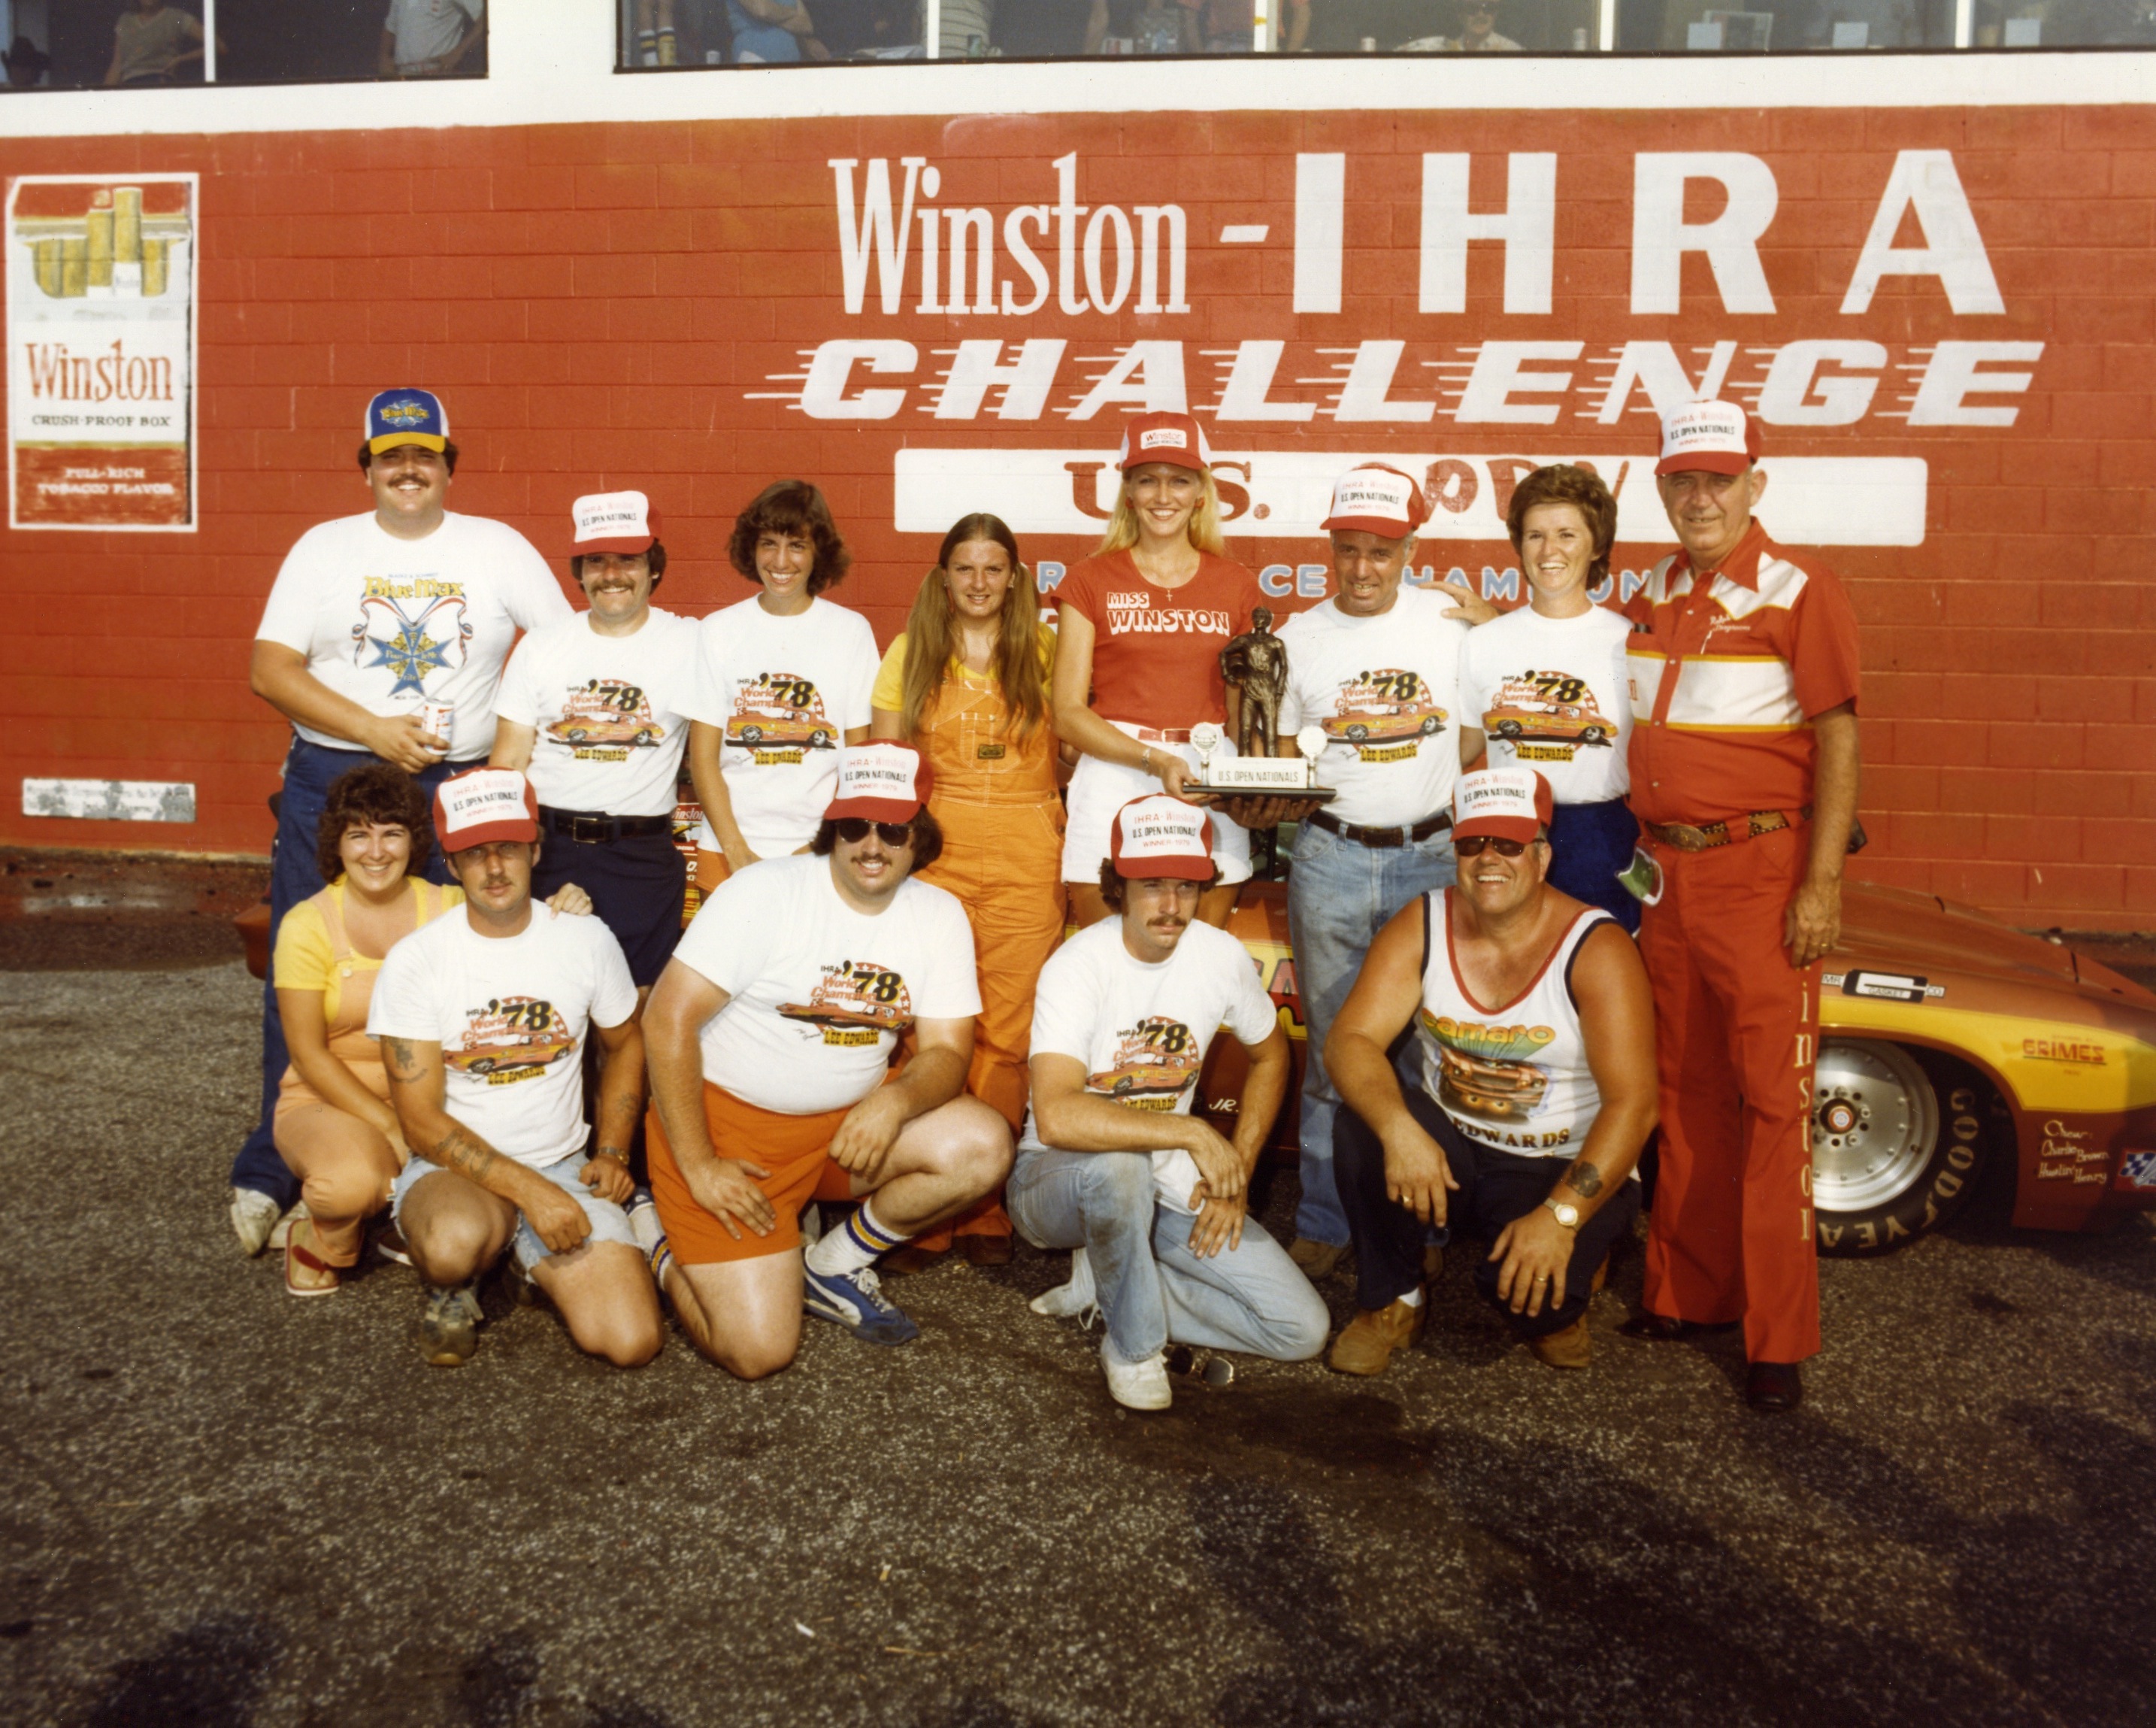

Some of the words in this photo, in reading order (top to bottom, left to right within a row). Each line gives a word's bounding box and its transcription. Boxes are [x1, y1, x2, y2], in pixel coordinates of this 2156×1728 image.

[828, 151, 1191, 316] Winston
[25, 338, 174, 403] Winston
[800, 339, 2045, 426] CHALLENGE
[140, 417, 171, 427] BOX
[364, 575, 414, 599] Blue
[414, 578, 464, 597] Max
[1107, 592, 1150, 610] MISS
[1107, 608, 1230, 637] WINSTON
[741, 687, 777, 698] World
[1361, 749, 1376, 762] LEE
[1379, 744, 1417, 761] EDWARDS
[1518, 745, 1531, 759] LEE
[1534, 746, 1573, 761] EDWARDS
[872, 771, 907, 783] NATIONALS
[1235, 771, 1254, 782] OPEN
[1256, 772, 1298, 782] NATIONALS
[466, 796, 483, 808] OPEN
[484, 792, 518, 802] NATIONALS
[1473, 790, 1488, 799] OPEN
[1491, 787, 1525, 799] NATIONALS
[1144, 826, 1161, 836] OPEN
[1164, 826, 1196, 837] NATIONALS
[823, 975, 858, 989] World
[810, 986, 877, 1002] Champion
[1867, 987, 1904, 998] GASKET
[825, 1030, 840, 1044] LEE
[843, 1030, 879, 1044] EDWARDS
[2023, 1038, 2105, 1062] GRIMES
[1209, 1099, 1239, 1112] JR.
[1453, 1117, 1570, 1149] EDWARDS
